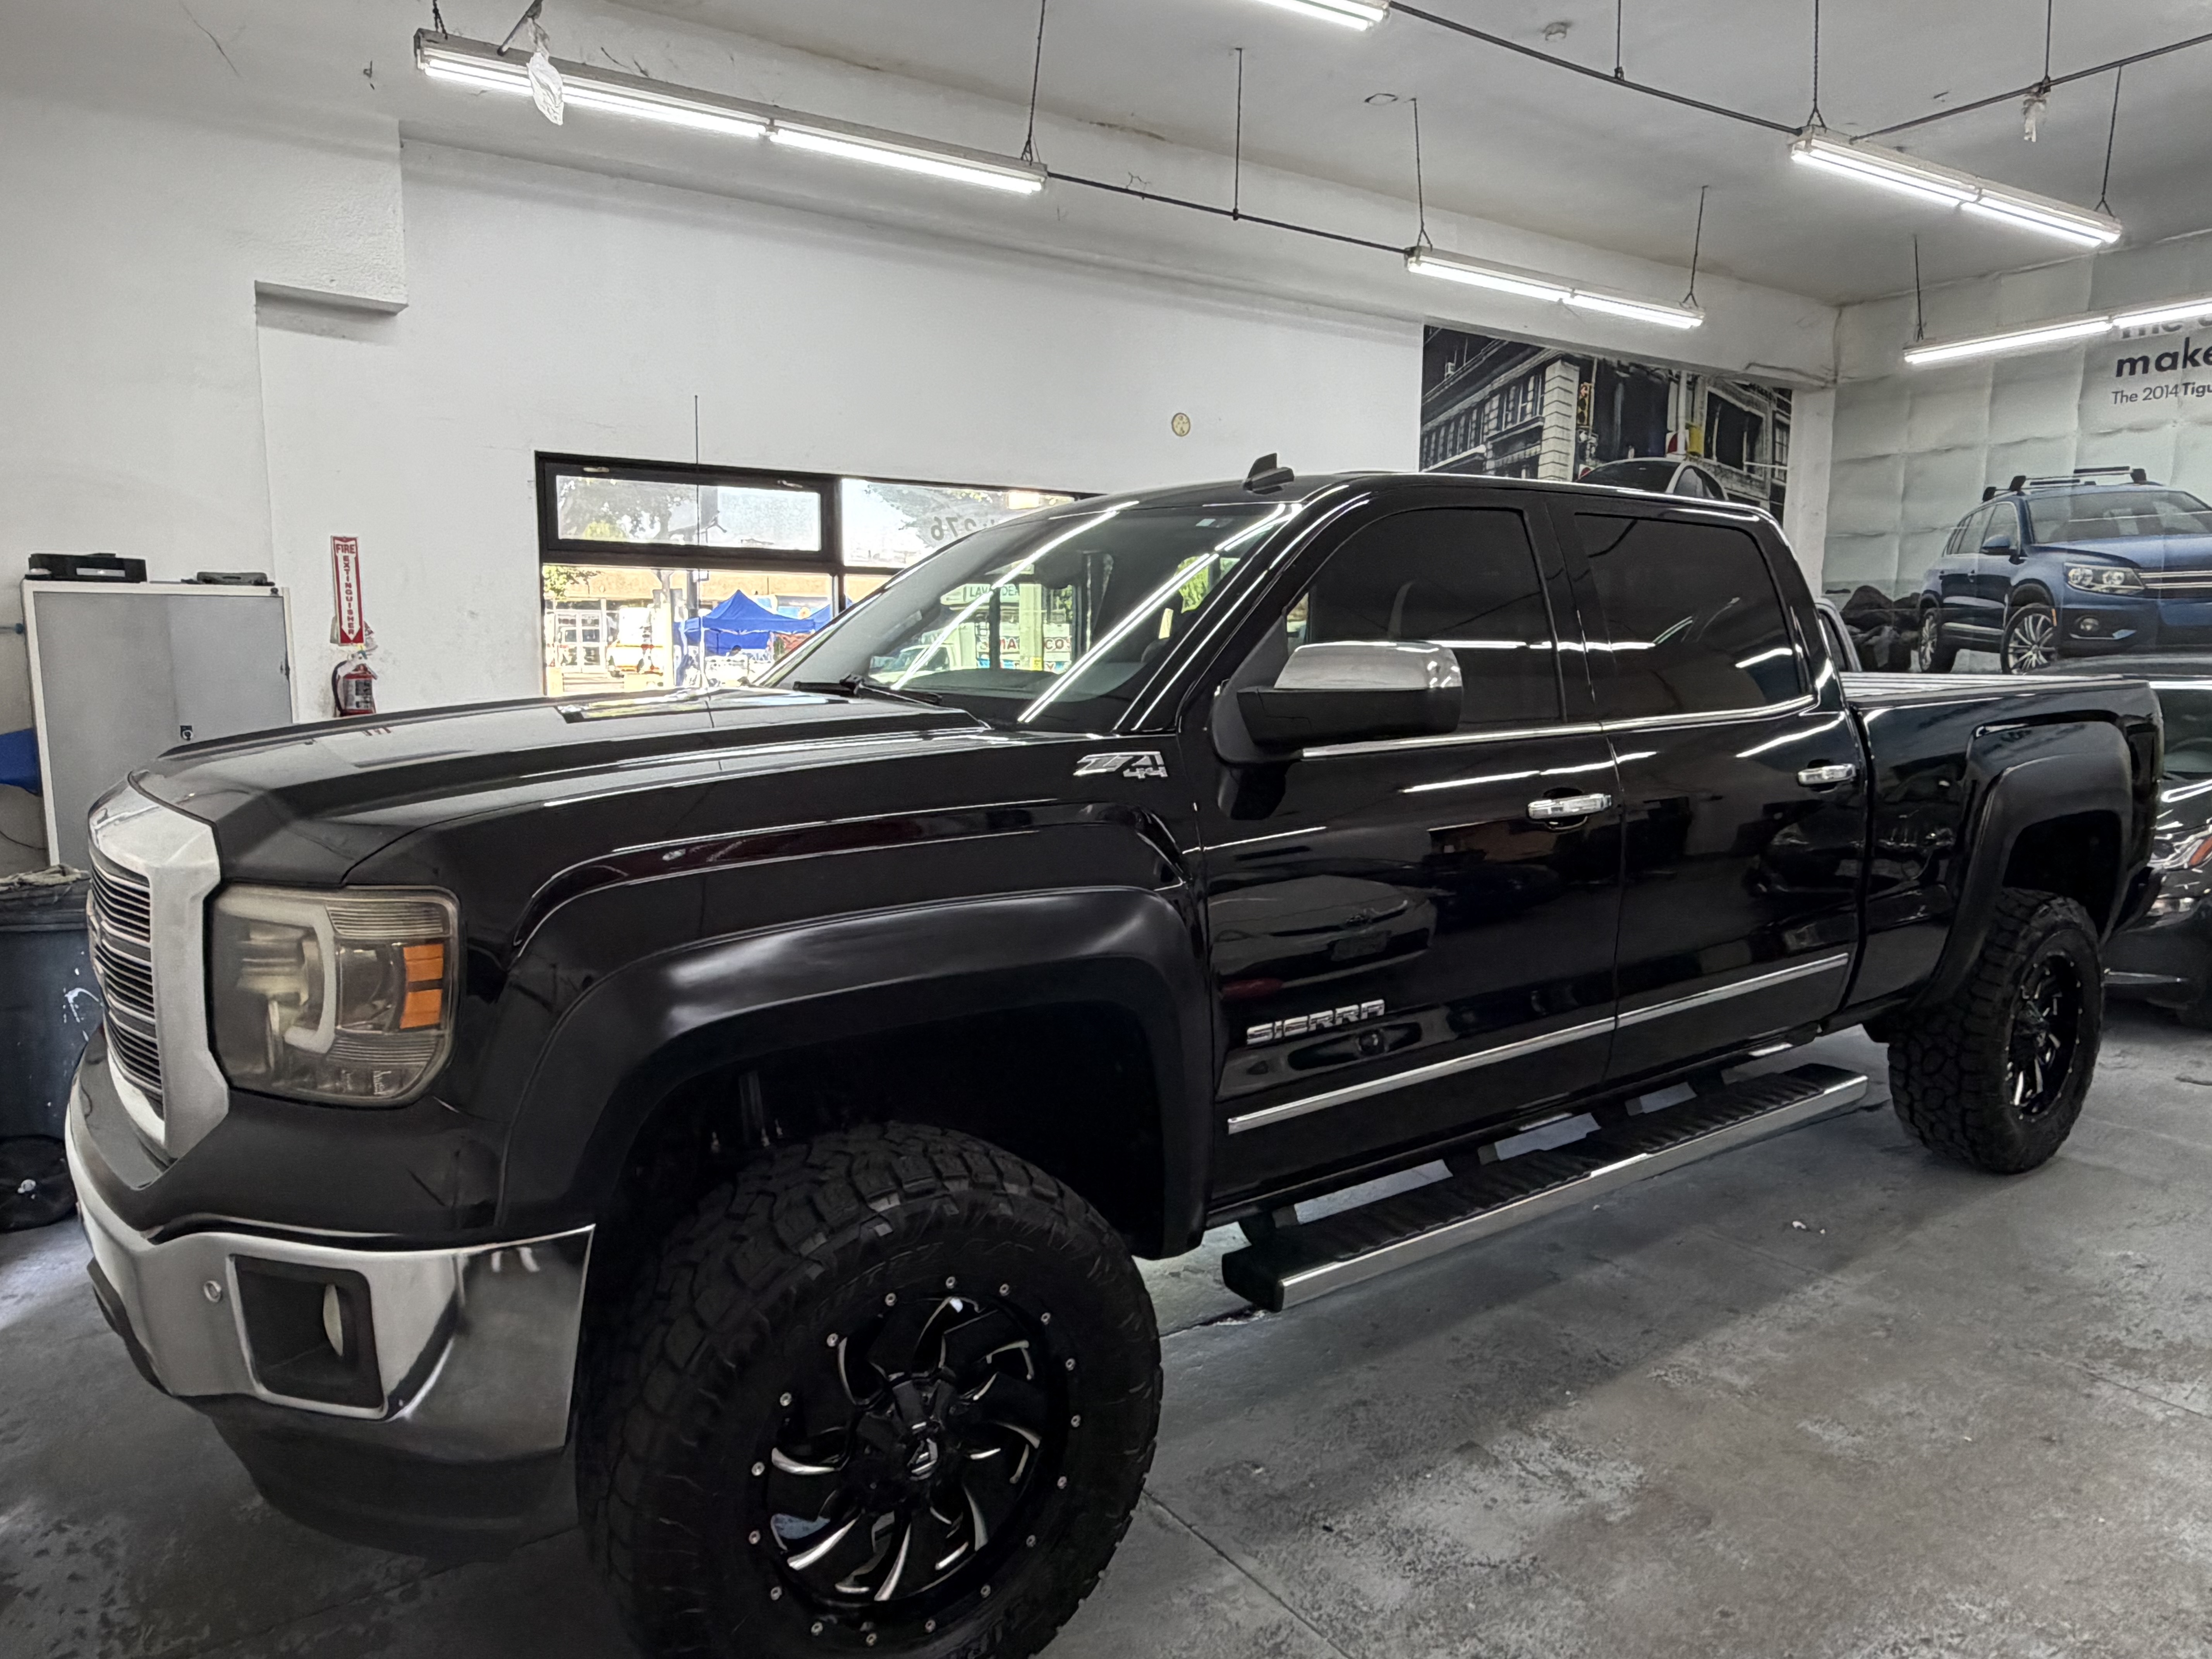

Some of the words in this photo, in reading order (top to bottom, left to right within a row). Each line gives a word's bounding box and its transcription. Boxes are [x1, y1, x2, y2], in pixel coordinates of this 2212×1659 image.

[2111, 390, 2138, 404] The
[2142, 384, 2179, 401] 2014
[336, 543, 356, 554] FIRE
[343, 555, 355, 635] EXTINGUISHER
[1247, 999, 1385, 1045] SIERRA
